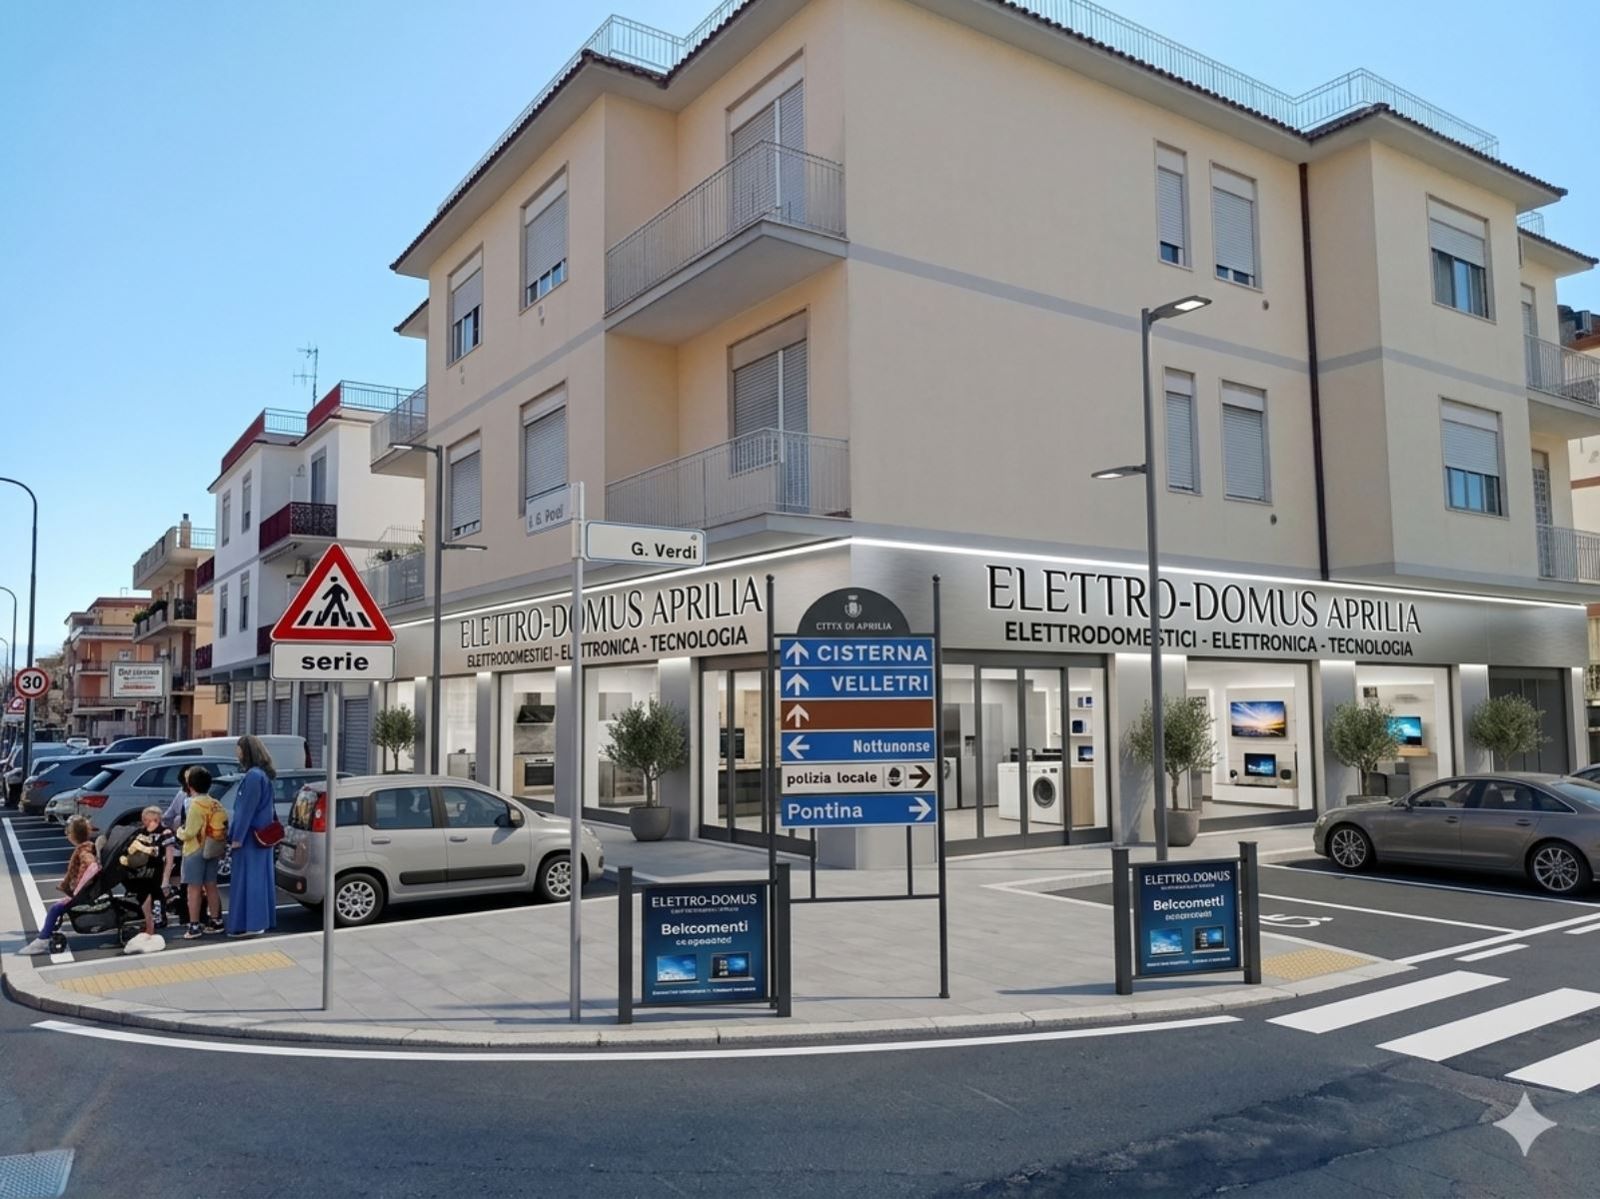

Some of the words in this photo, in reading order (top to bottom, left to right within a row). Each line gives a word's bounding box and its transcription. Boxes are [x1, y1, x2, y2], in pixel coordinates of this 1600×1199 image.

[631, 541, 649, 557] G.
[655, 543, 697, 560] Verdi
[651, 575, 763, 625] APRILIA
[986, 564, 1318, 628] ELETTRO-DOMUS
[1326, 597, 1422, 634] APRILIA
[845, 622, 855, 631] DI
[857, 622, 892, 631] APRILIA
[561, 636, 640, 661] ELTTRONICA
[650, 625, 749, 653] TECNOLOGIA
[1212, 631, 1317, 653] ELETTRONICA
[1328, 636, 1414, 657] TECNOLOGIA
[301, 651, 369, 671] serie
[817, 644, 928, 662] CISTERNA
[22, 675, 42, 690] 30
[831, 674, 929, 692] VELLETRI
[853, 739, 930, 754] Nottunonse
[787, 771, 832, 788] polizia
[837, 771, 877, 784] locale
[788, 802, 864, 820] Pontina
[651, 893, 758, 908] ELETTRO-DOMUS
